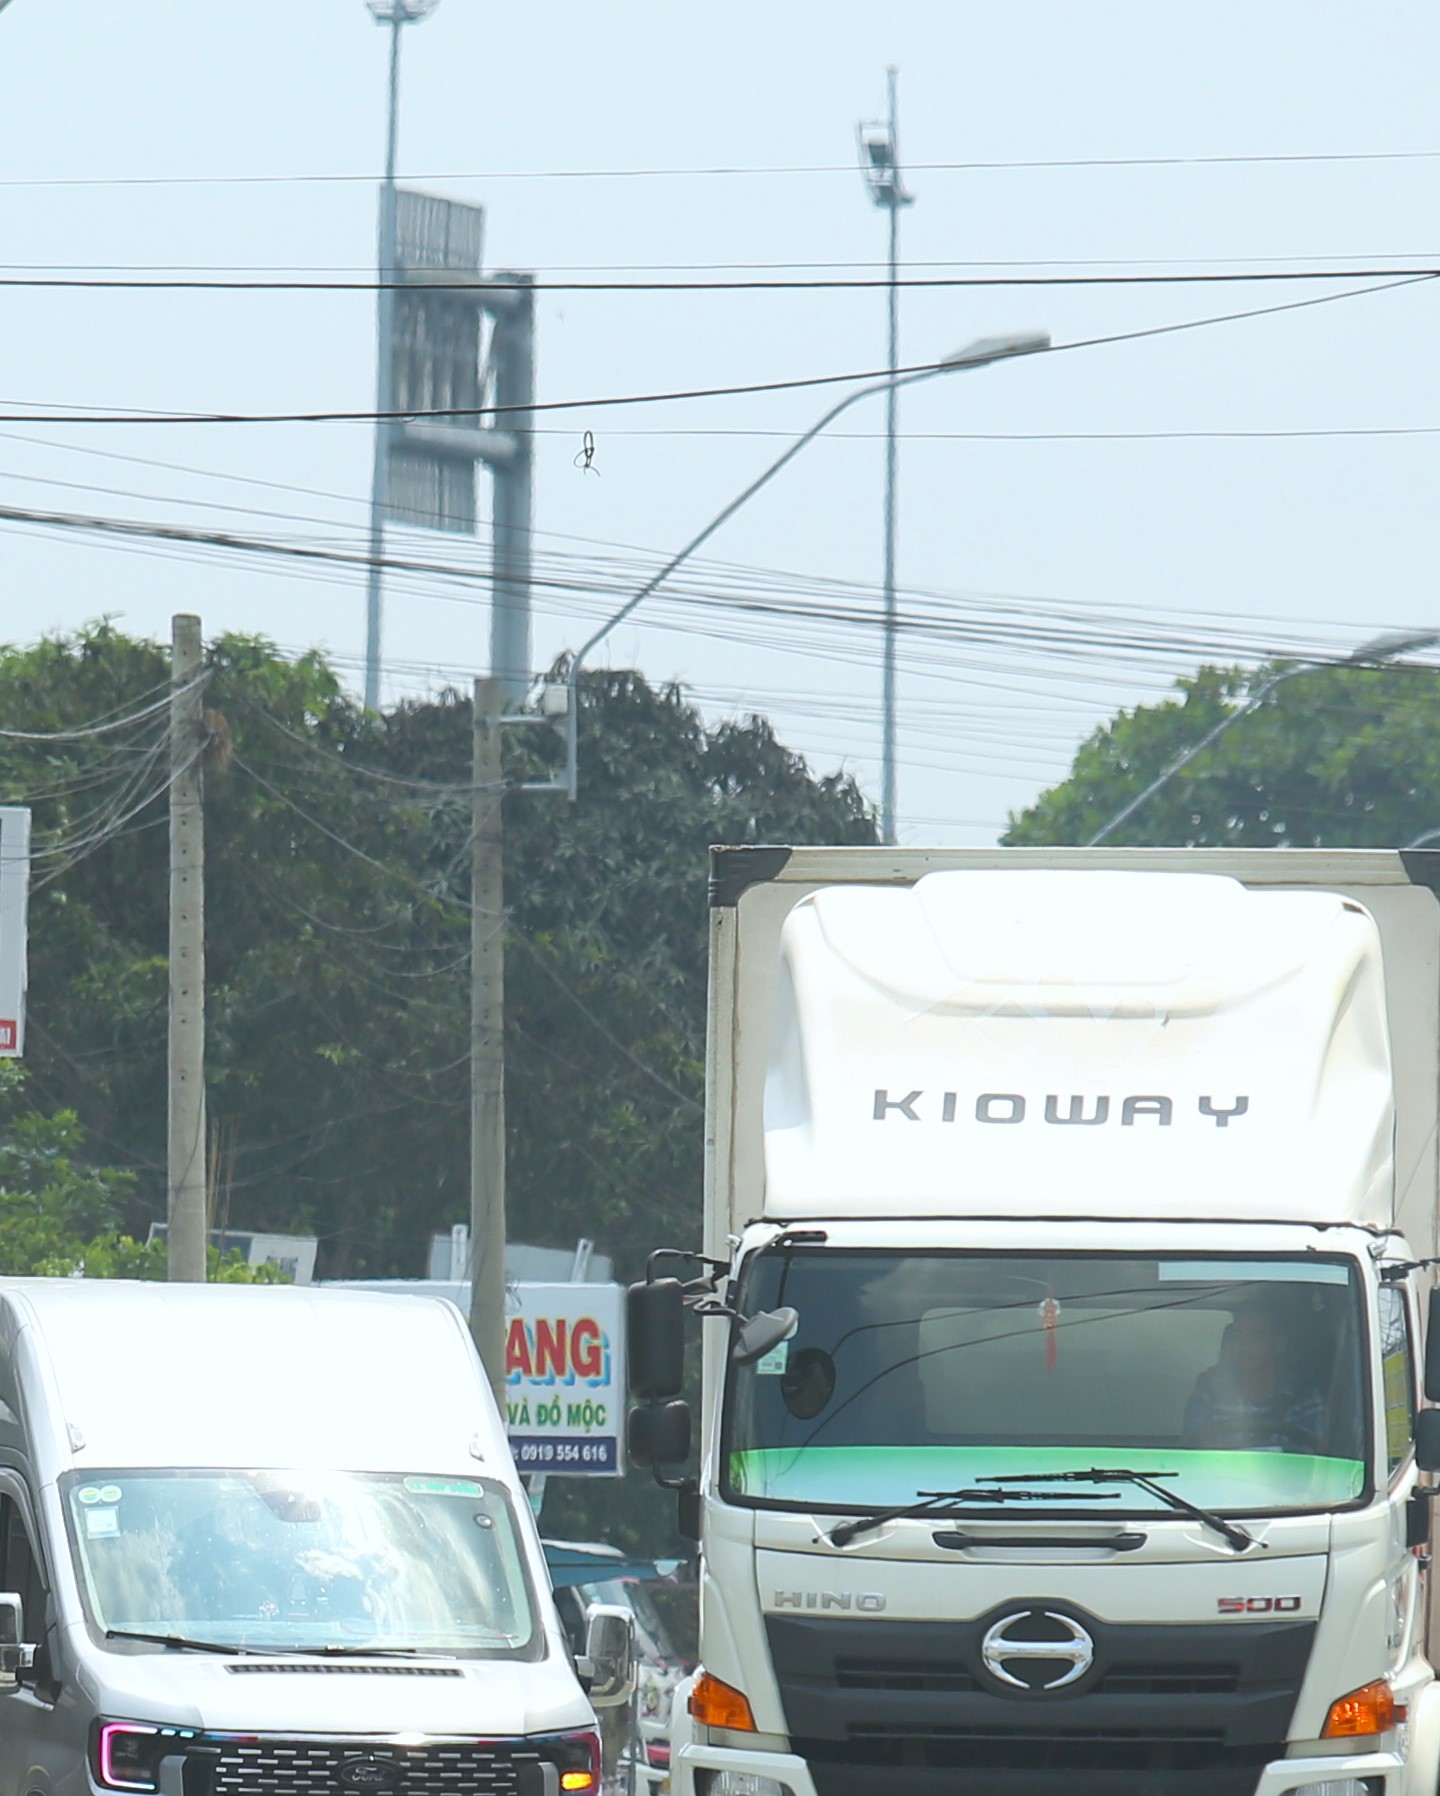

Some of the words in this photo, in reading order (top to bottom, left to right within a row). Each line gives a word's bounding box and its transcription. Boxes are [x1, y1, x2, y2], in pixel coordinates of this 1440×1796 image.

[872, 1088, 1250, 1128] KIOWAY
[505, 1317, 604, 1380] ANG
[506, 1397, 532, 1426] VÀ
[567, 1399, 607, 1434] MỘC
[555, 1444, 580, 1461] 554
[582, 1444, 608, 1461] 616
[774, 1589, 887, 1612] HINO
[1217, 1596, 1302, 1614] 500
[351, 1766, 386, 1783] Ford
